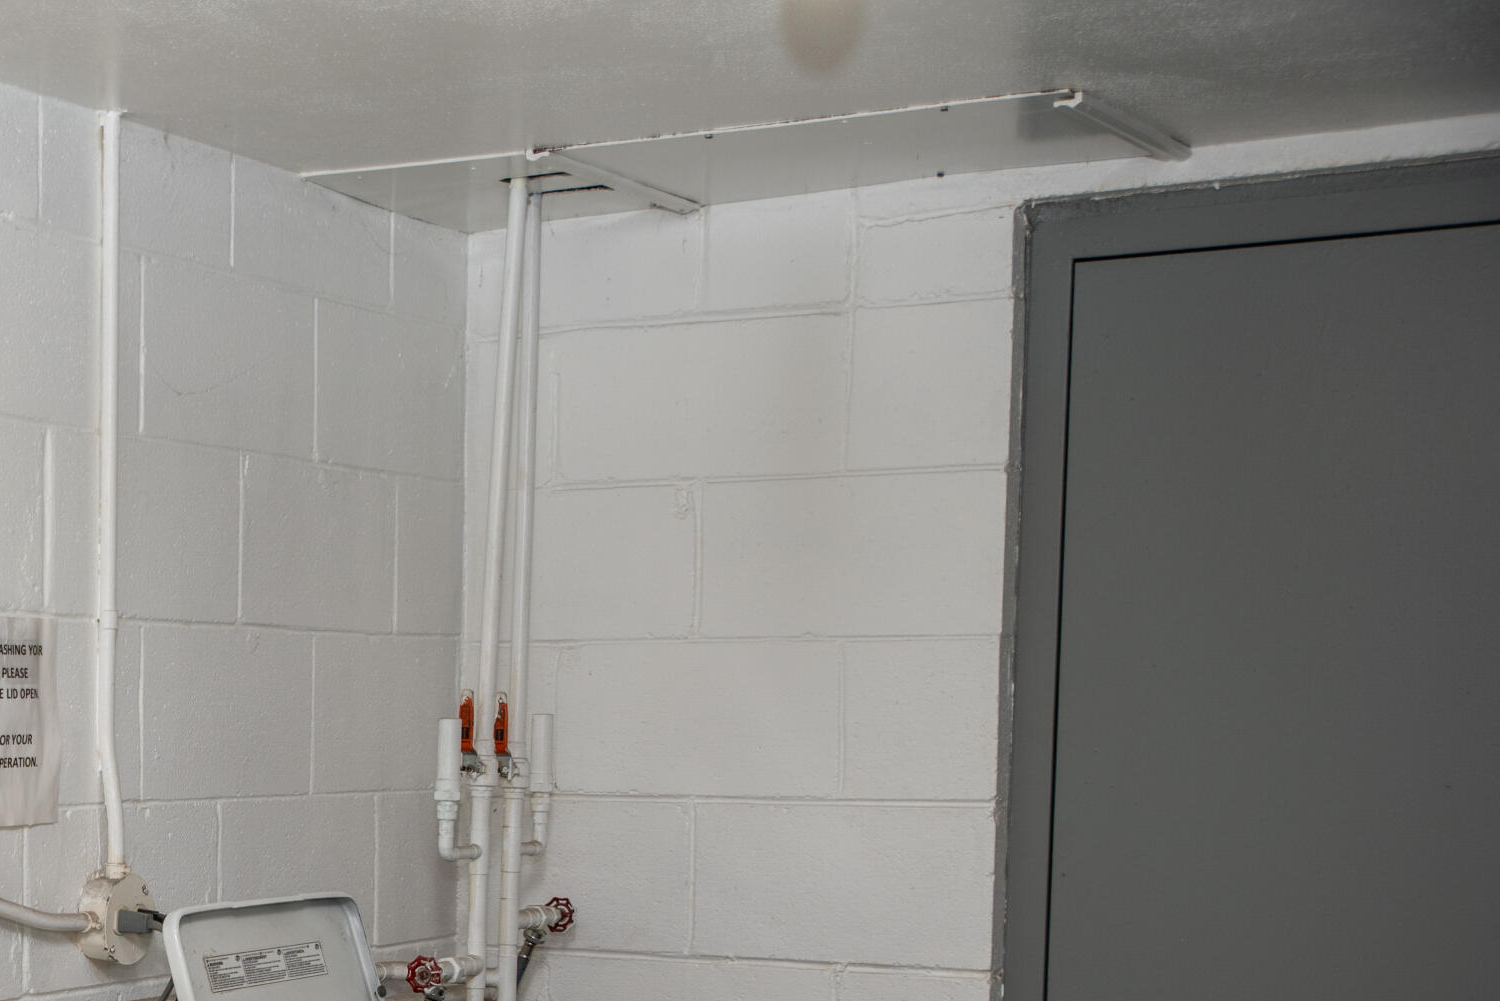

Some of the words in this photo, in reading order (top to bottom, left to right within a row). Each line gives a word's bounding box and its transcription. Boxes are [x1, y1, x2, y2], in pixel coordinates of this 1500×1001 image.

[2, 667, 29, 679] PLEASE
[6, 688, 18, 700] LID
[11, 734, 33, 745] YOUR
